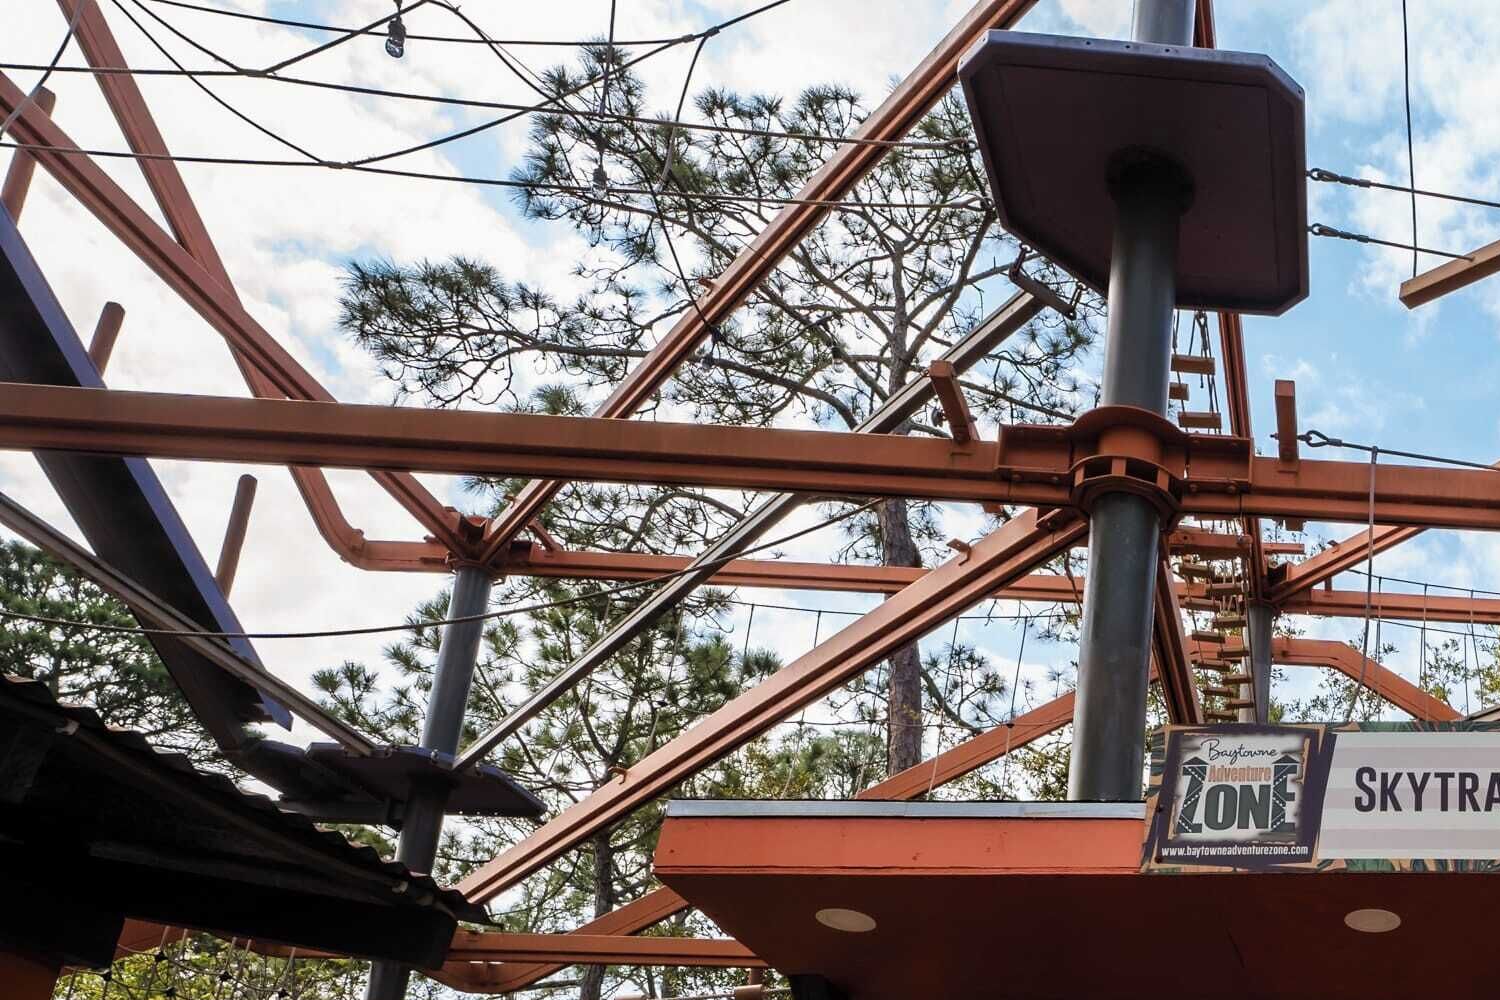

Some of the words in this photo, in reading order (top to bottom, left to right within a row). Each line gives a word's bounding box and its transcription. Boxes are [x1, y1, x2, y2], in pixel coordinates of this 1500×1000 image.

[1201, 738, 1278, 765] Baytowne
[1208, 765, 1271, 782] Adventure
[1177, 764, 1298, 833] ZONE
[1161, 844, 1309, 858] www.baytowneadventurezone.com
